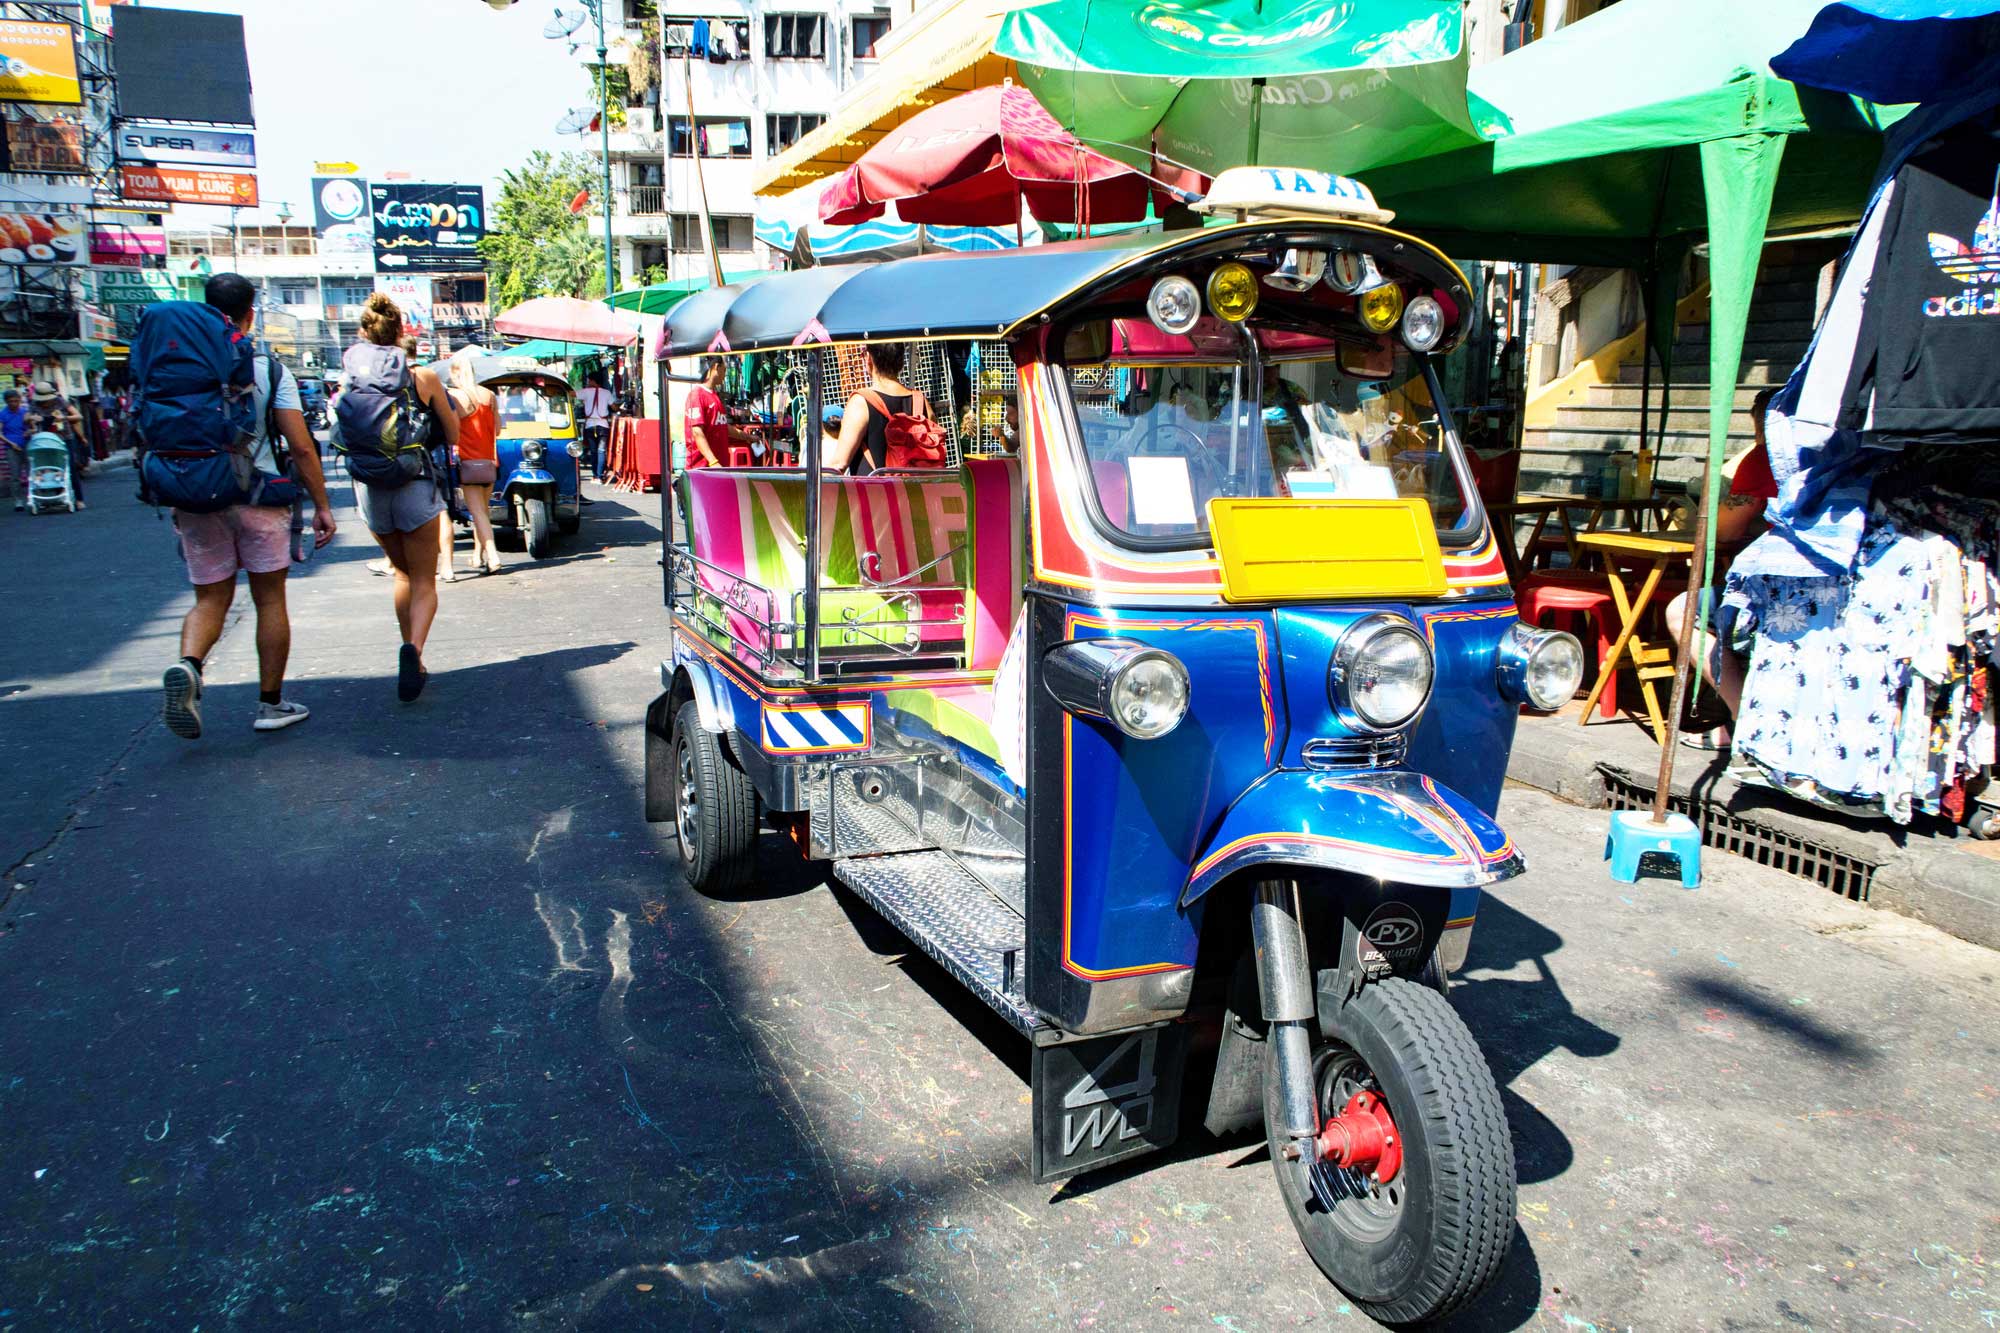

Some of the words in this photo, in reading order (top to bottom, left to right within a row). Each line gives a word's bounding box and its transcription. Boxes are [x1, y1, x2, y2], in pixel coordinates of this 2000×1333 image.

[126, 135, 195, 151] SUPER
[128, 174, 159, 189] TOM
[162, 177, 195, 191] YUM
[197, 179, 236, 194] KUNG
[1261, 169, 1366, 201] TAXI
[104, 288, 176, 300] DRUGSTORE
[392, 285, 416, 293] ASIA
